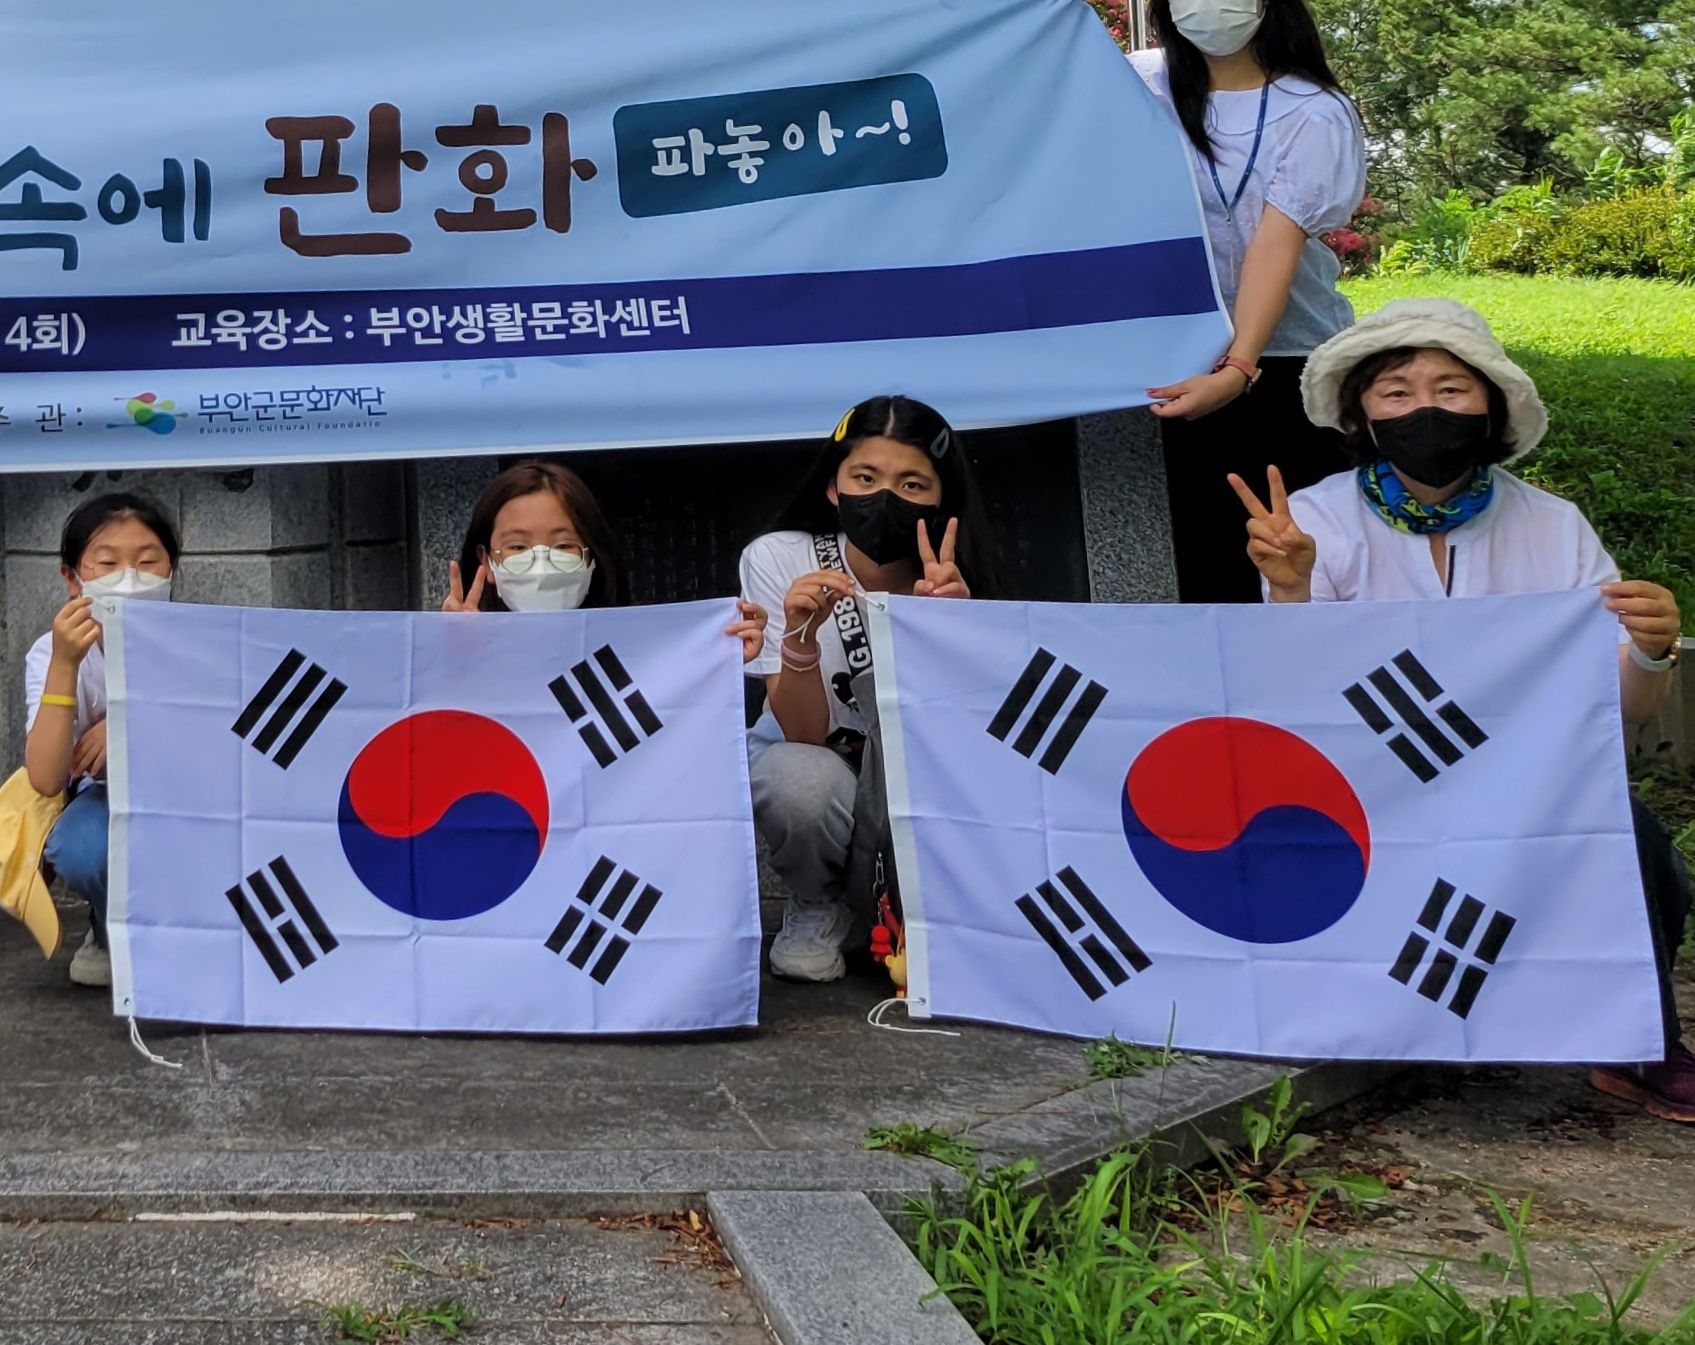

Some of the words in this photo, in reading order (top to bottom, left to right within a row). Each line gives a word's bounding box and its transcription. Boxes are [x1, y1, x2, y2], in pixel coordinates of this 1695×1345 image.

[264, 102, 597, 257] 판화
[5, 313, 86, 356] 4회)
[172, 309, 333, 351] 교육장소
[366, 296, 691, 346] 부안생활문화센터
[198, 385, 388, 423] 부안군문화재단
[199, 425, 252, 435] Buangun
[259, 423, 311, 433] Cultural
